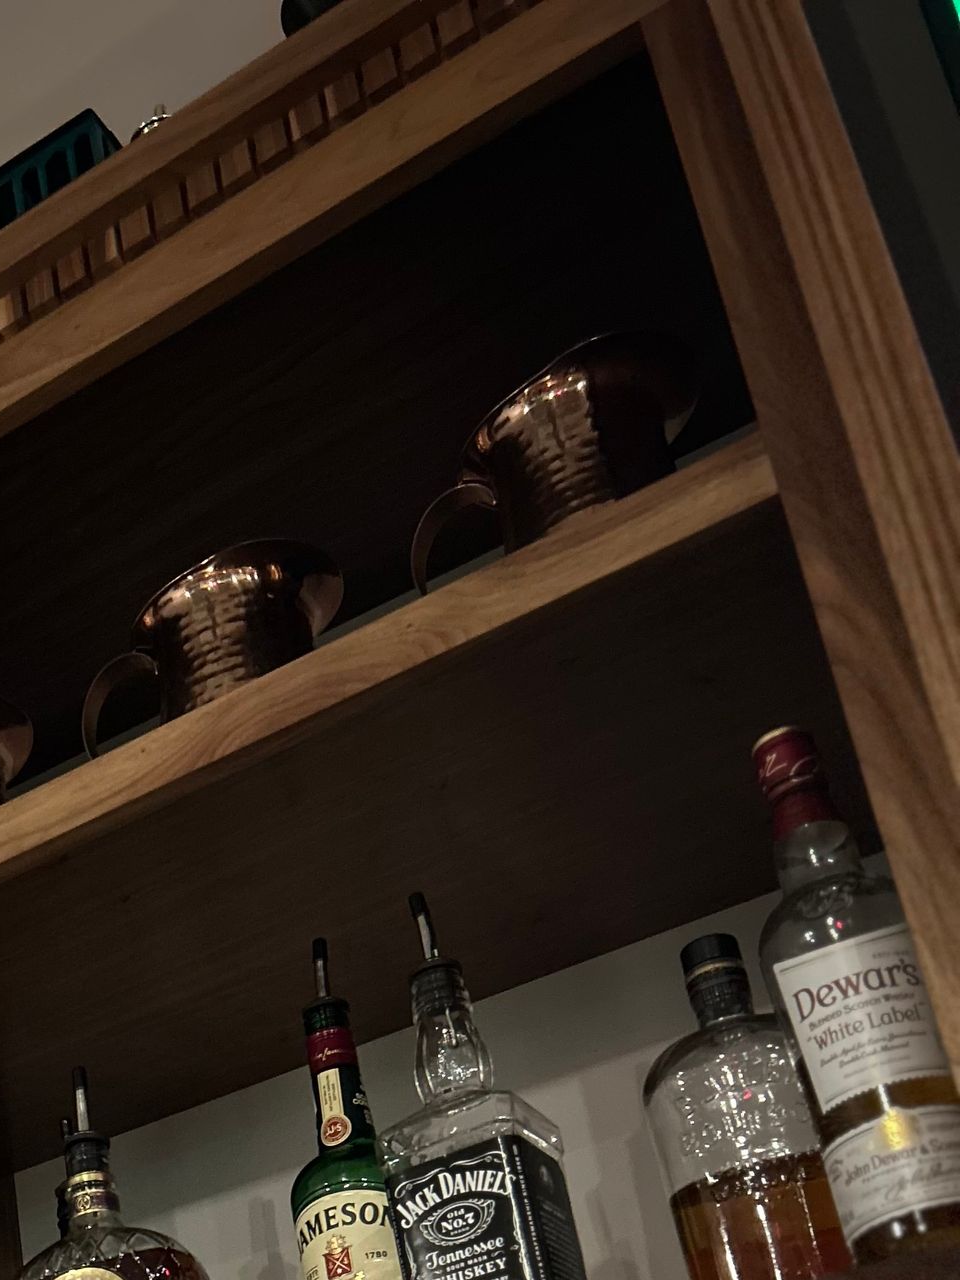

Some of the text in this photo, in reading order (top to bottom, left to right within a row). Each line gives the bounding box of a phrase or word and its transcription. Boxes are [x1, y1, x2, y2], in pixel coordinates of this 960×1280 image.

[792, 958, 921, 1024] Dewar's
[396, 1183, 443, 1230] JACK
[446, 1208, 466, 1220] Old
[440, 1211, 476, 1234] No.7
[364, 1250, 389, 1260] 1780
[425, 1236, 505, 1270] Tennessee
[445, 1254, 488, 1273] SOUR MASH
